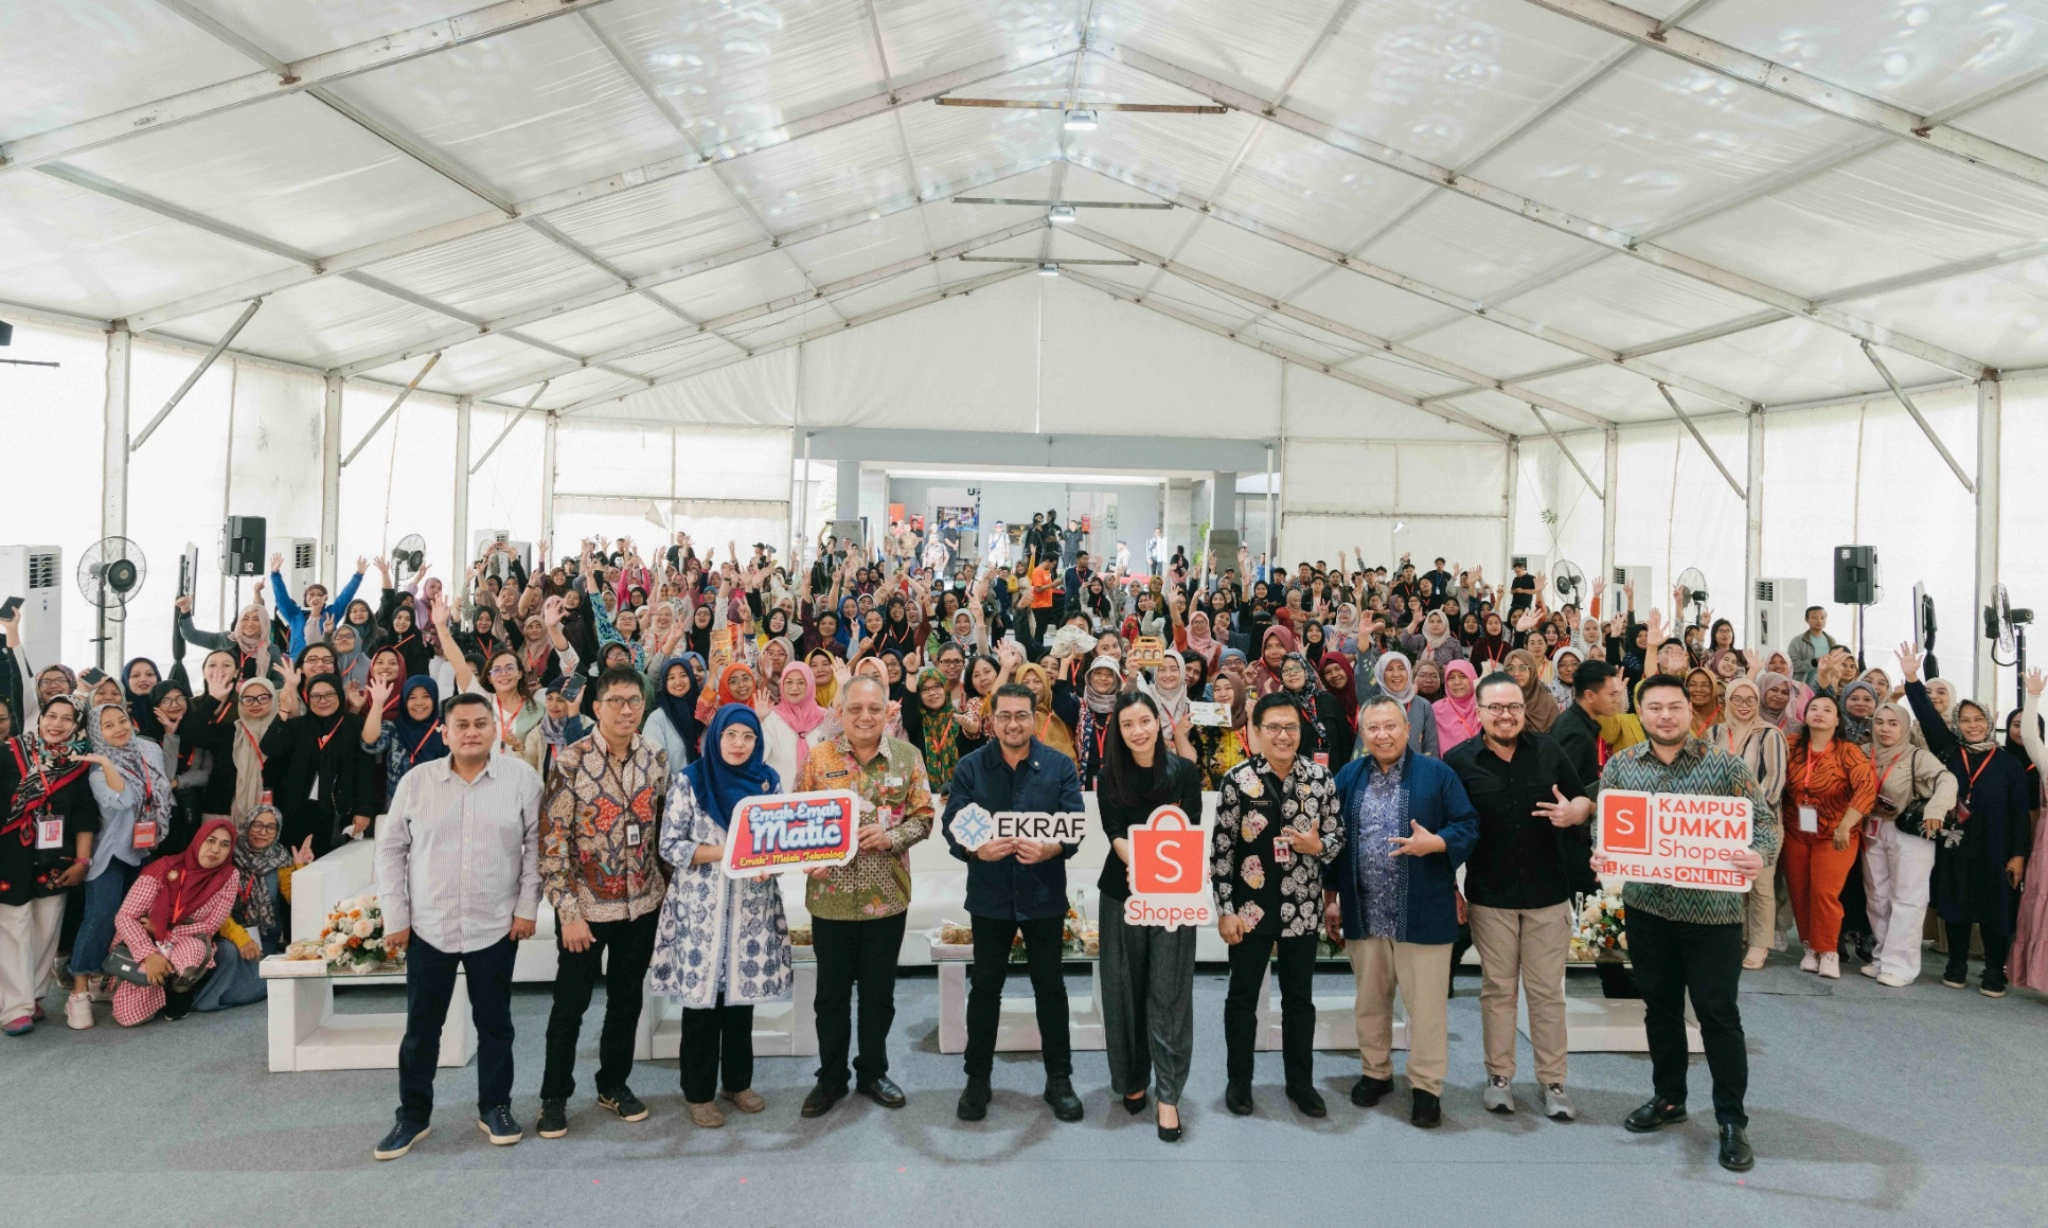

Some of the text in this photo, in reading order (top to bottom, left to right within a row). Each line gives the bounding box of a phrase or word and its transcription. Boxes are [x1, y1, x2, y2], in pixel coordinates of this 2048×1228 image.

[1659, 798, 1747, 817] KAMPUS
[998, 817, 1086, 838] EKRAF
[1615, 809, 1635, 835] S
[1659, 816, 1747, 840] UMKM
[750, 818, 842, 855] Matic
[772, 854, 801, 863] Melek
[803, 849, 846, 861] Teknologi
[1155, 840, 1183, 884] S
[1620, 863, 1673, 879] KELAS
[1677, 867, 1743, 886] ONLINE
[1129, 900, 1209, 926] Shopee
